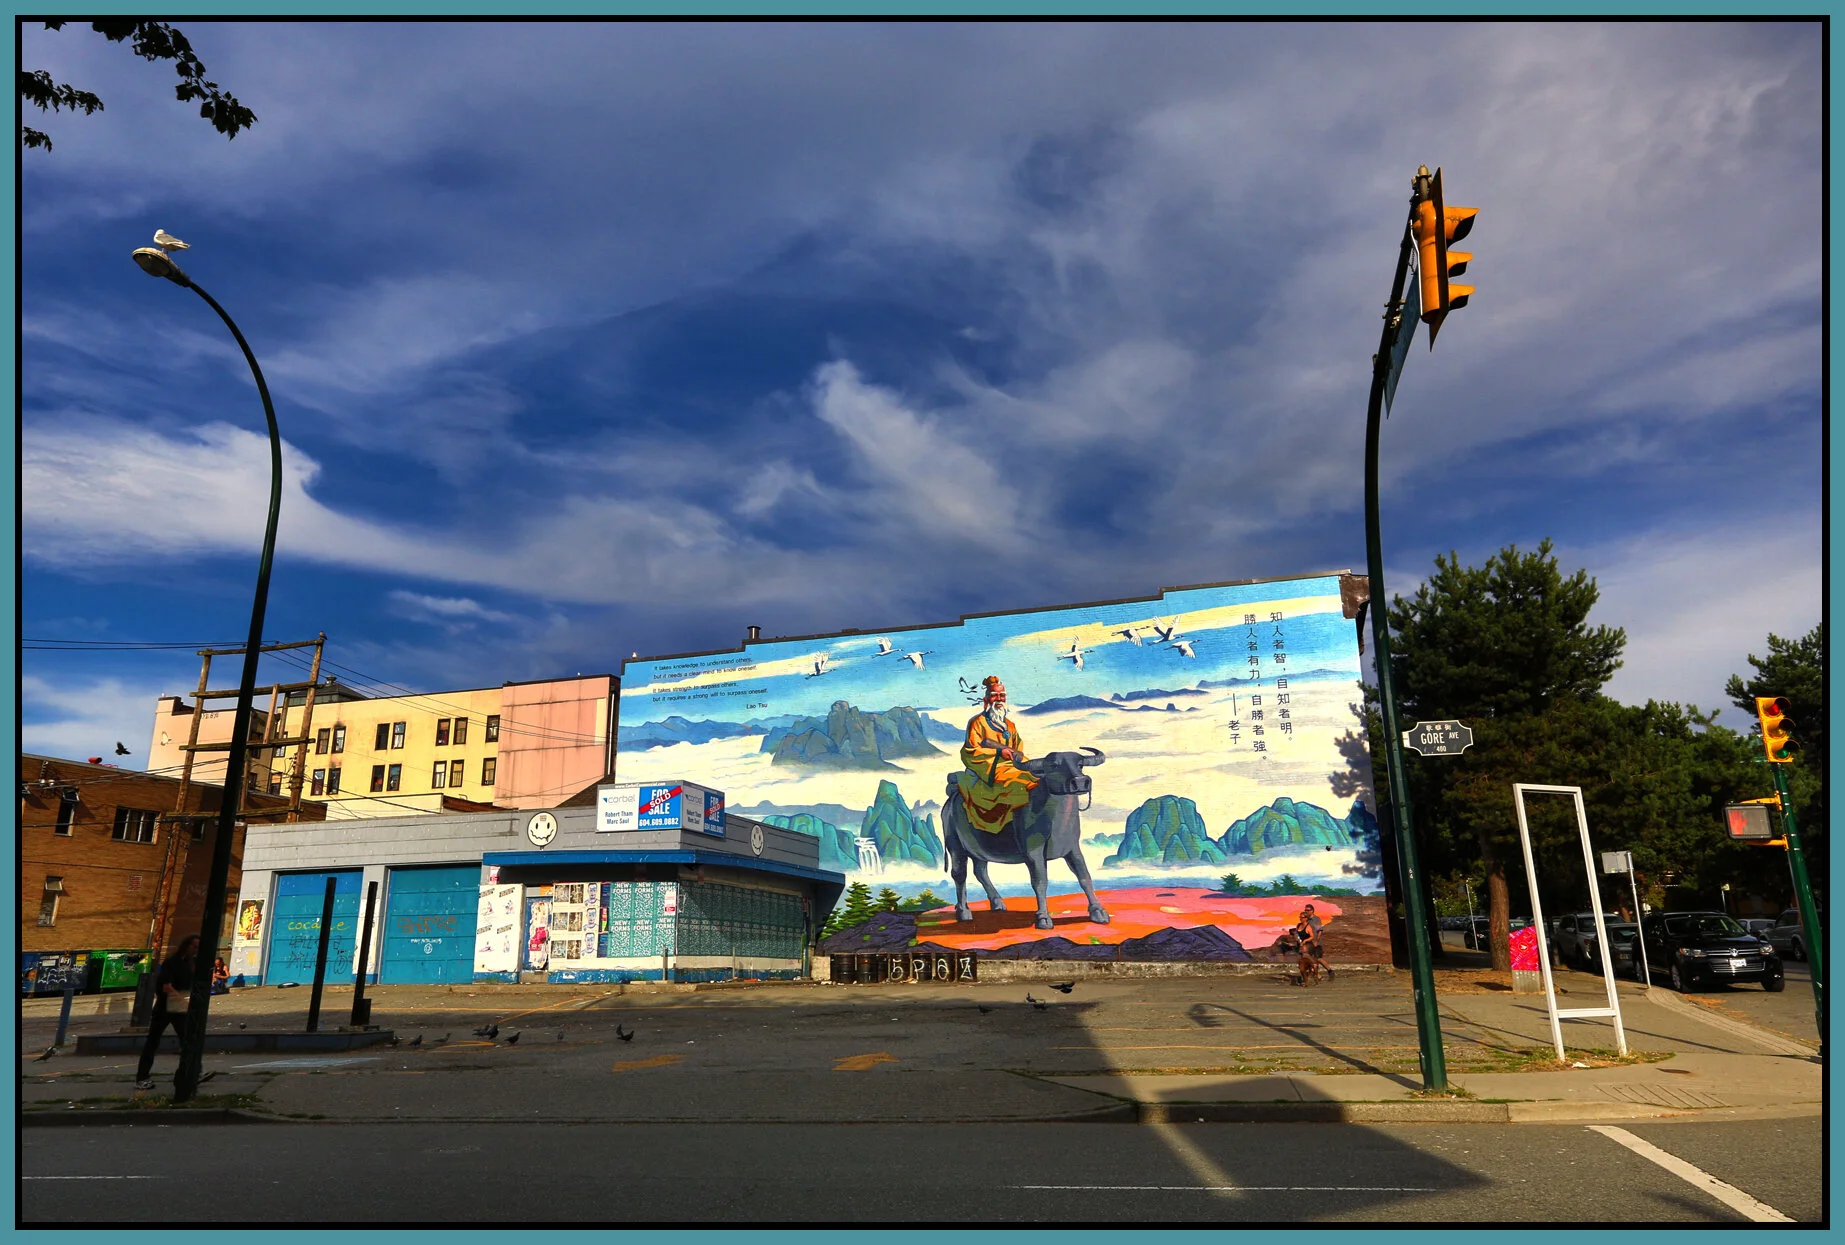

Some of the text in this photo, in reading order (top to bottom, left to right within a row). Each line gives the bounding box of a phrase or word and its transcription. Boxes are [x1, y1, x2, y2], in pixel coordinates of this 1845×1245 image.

[1420, 732, 1445, 744] GORE
[608, 794, 635, 803] corbel
[649, 793, 671, 808] SOLD
[648, 802, 670, 815] SALE
[288, 921, 350, 930] cocae
